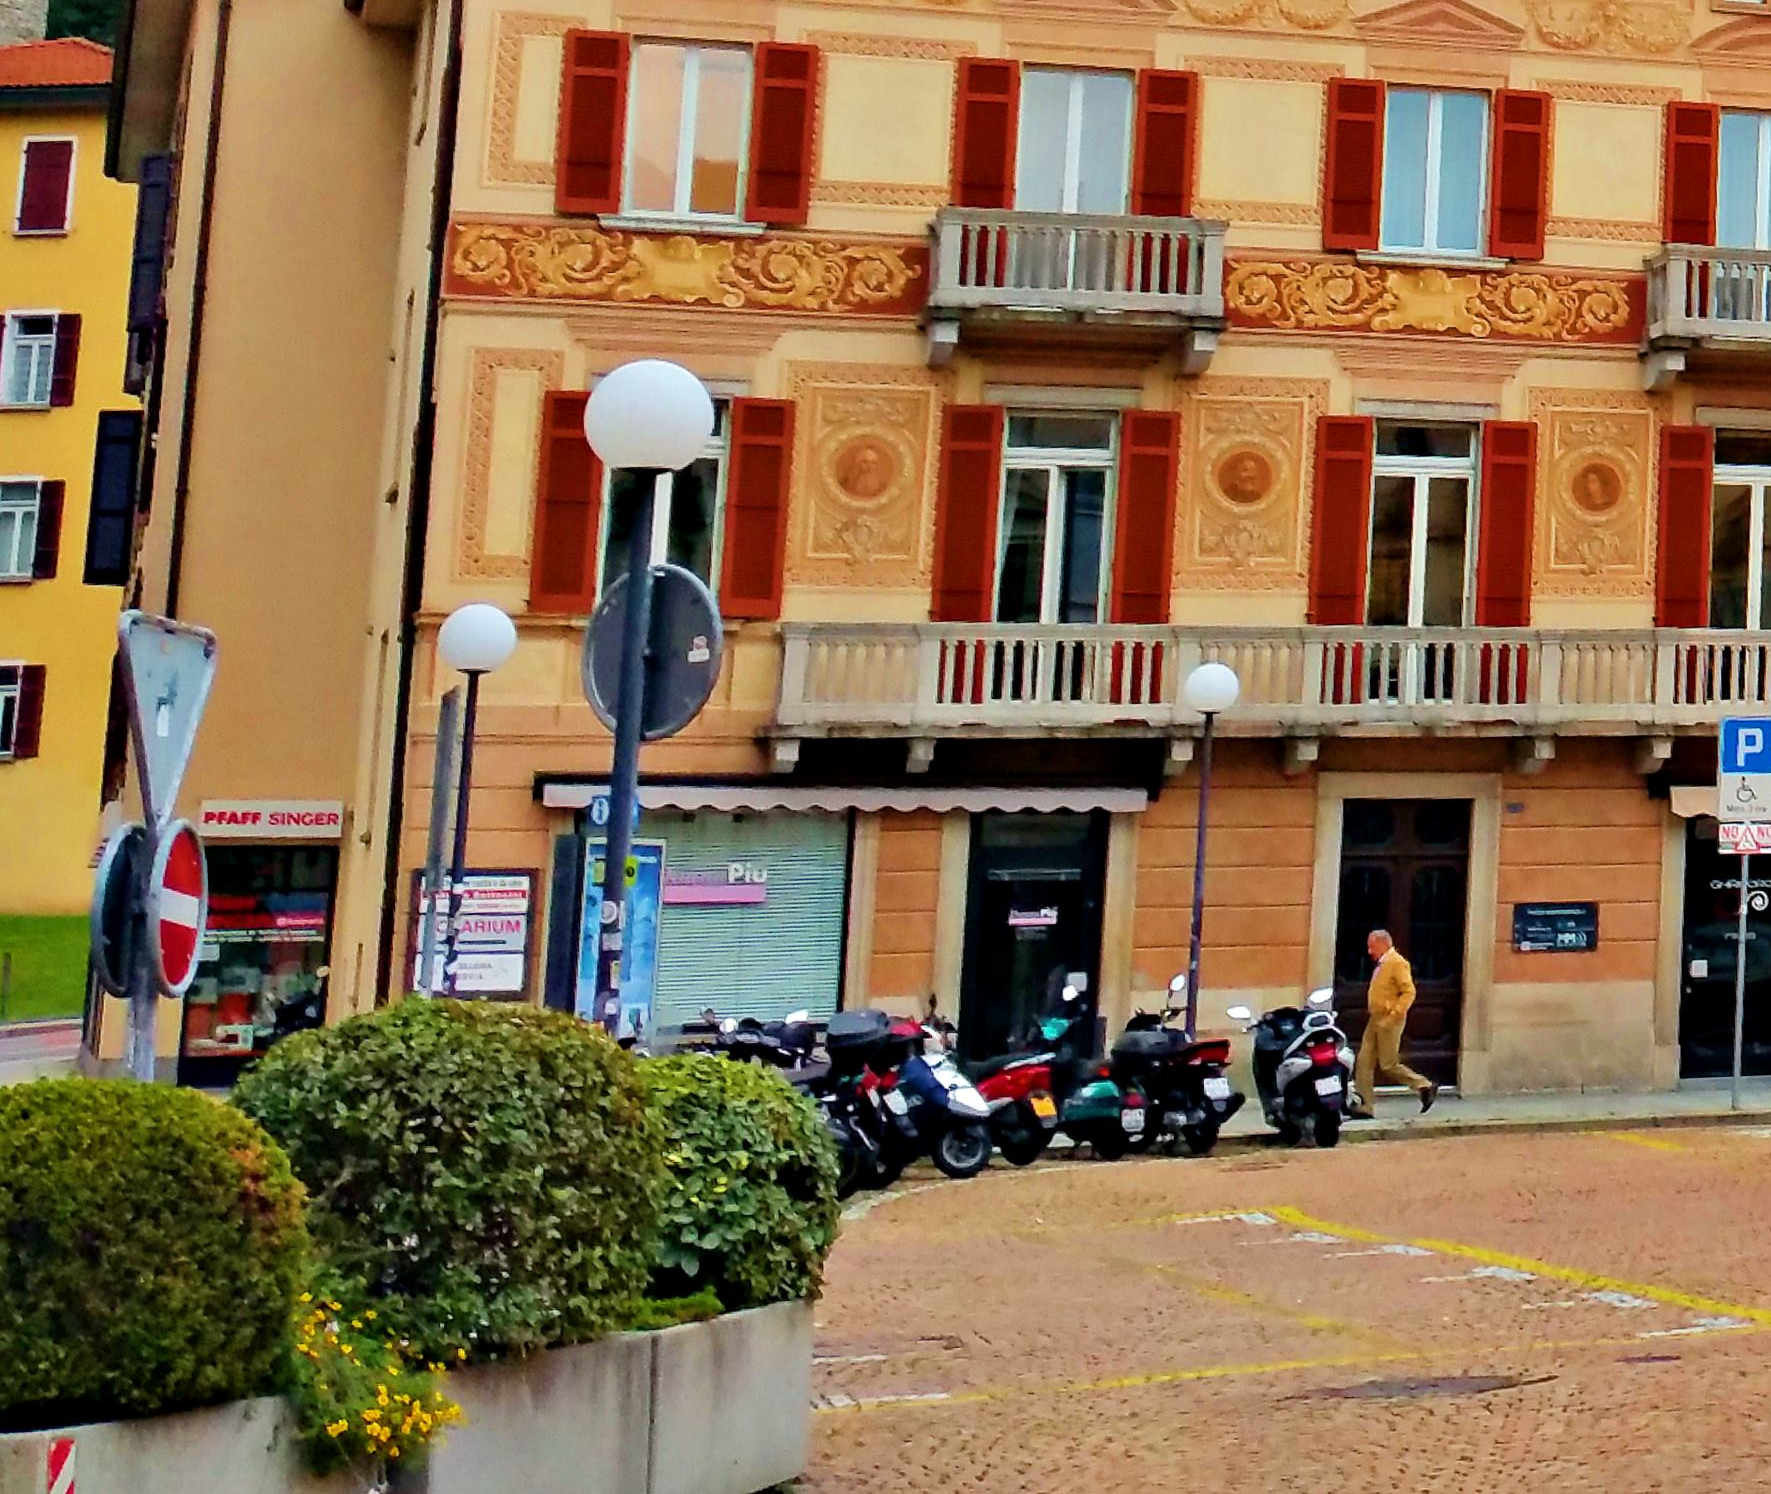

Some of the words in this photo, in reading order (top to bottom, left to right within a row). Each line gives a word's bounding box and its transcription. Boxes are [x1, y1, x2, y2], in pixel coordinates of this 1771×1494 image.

[1736, 728, 1764, 767] P
[203, 811, 262, 825] PFAFF
[268, 812, 340, 826] SINGER
